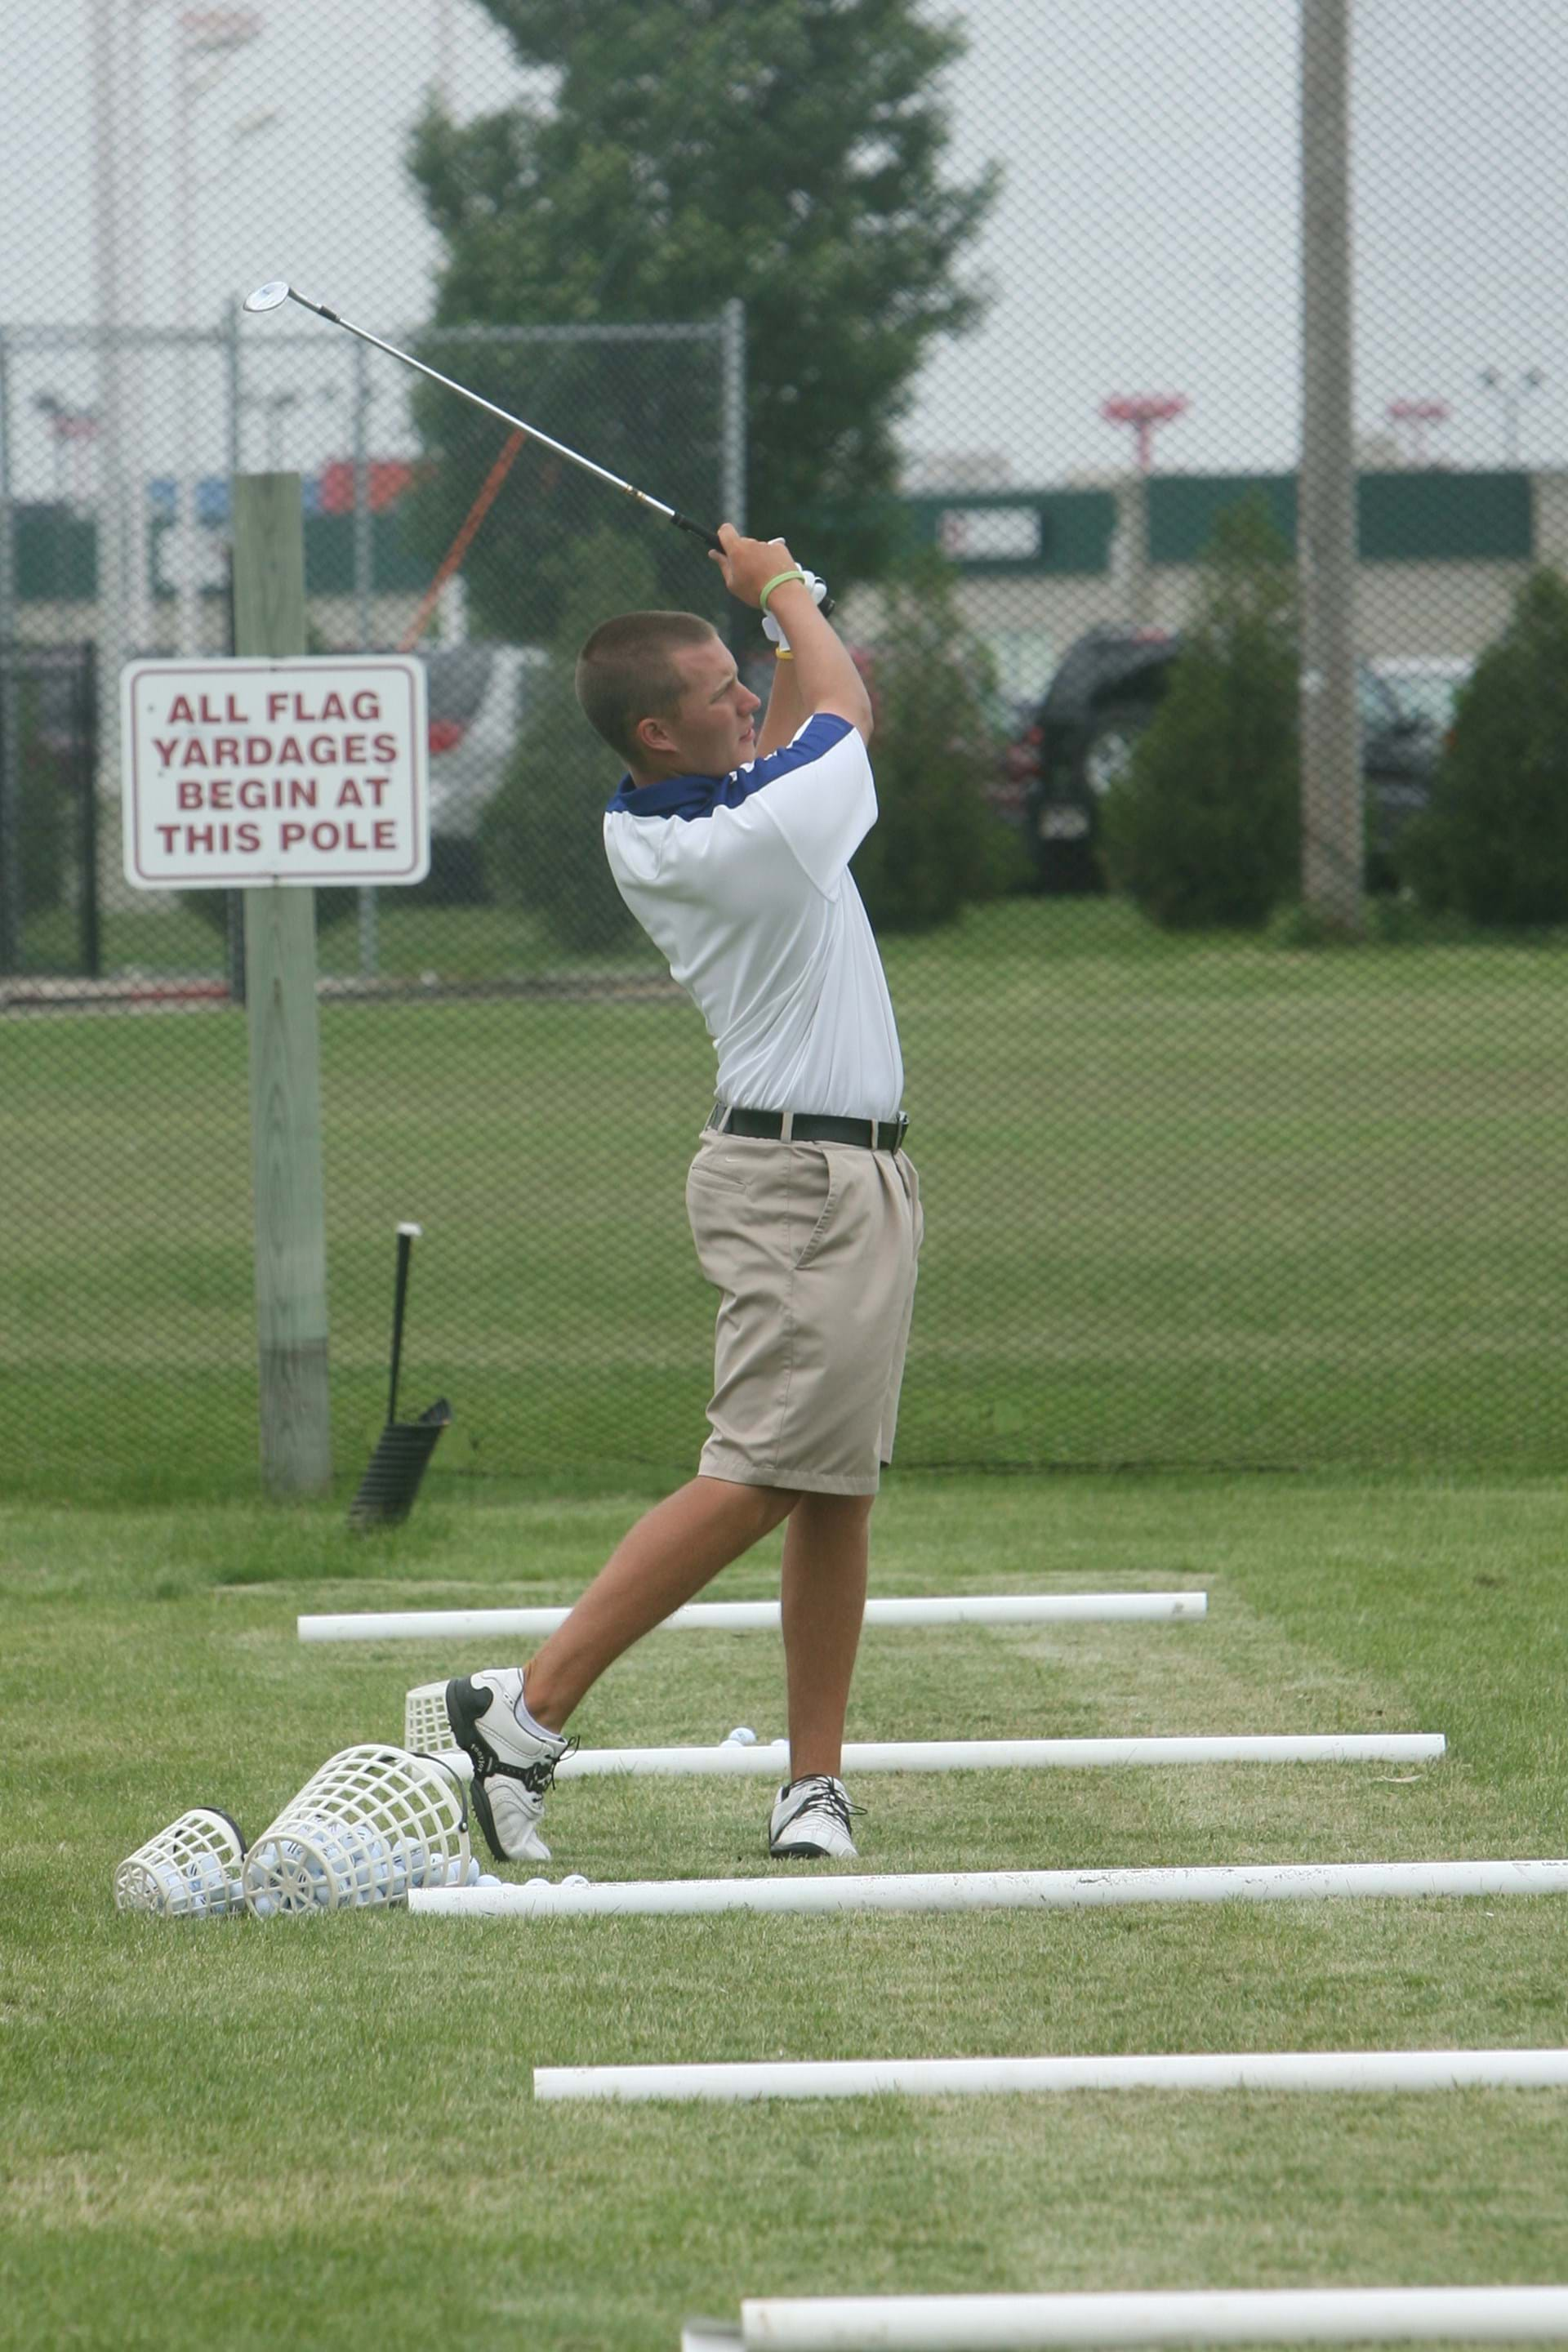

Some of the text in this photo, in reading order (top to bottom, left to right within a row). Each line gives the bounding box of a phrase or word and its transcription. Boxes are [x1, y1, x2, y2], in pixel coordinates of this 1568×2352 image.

[168, 690, 381, 724] ALL FLAG
[153, 733, 397, 768] YARDAGES
[176, 777, 390, 810] BEGIN AT
[156, 820, 397, 853] THIS POLE
